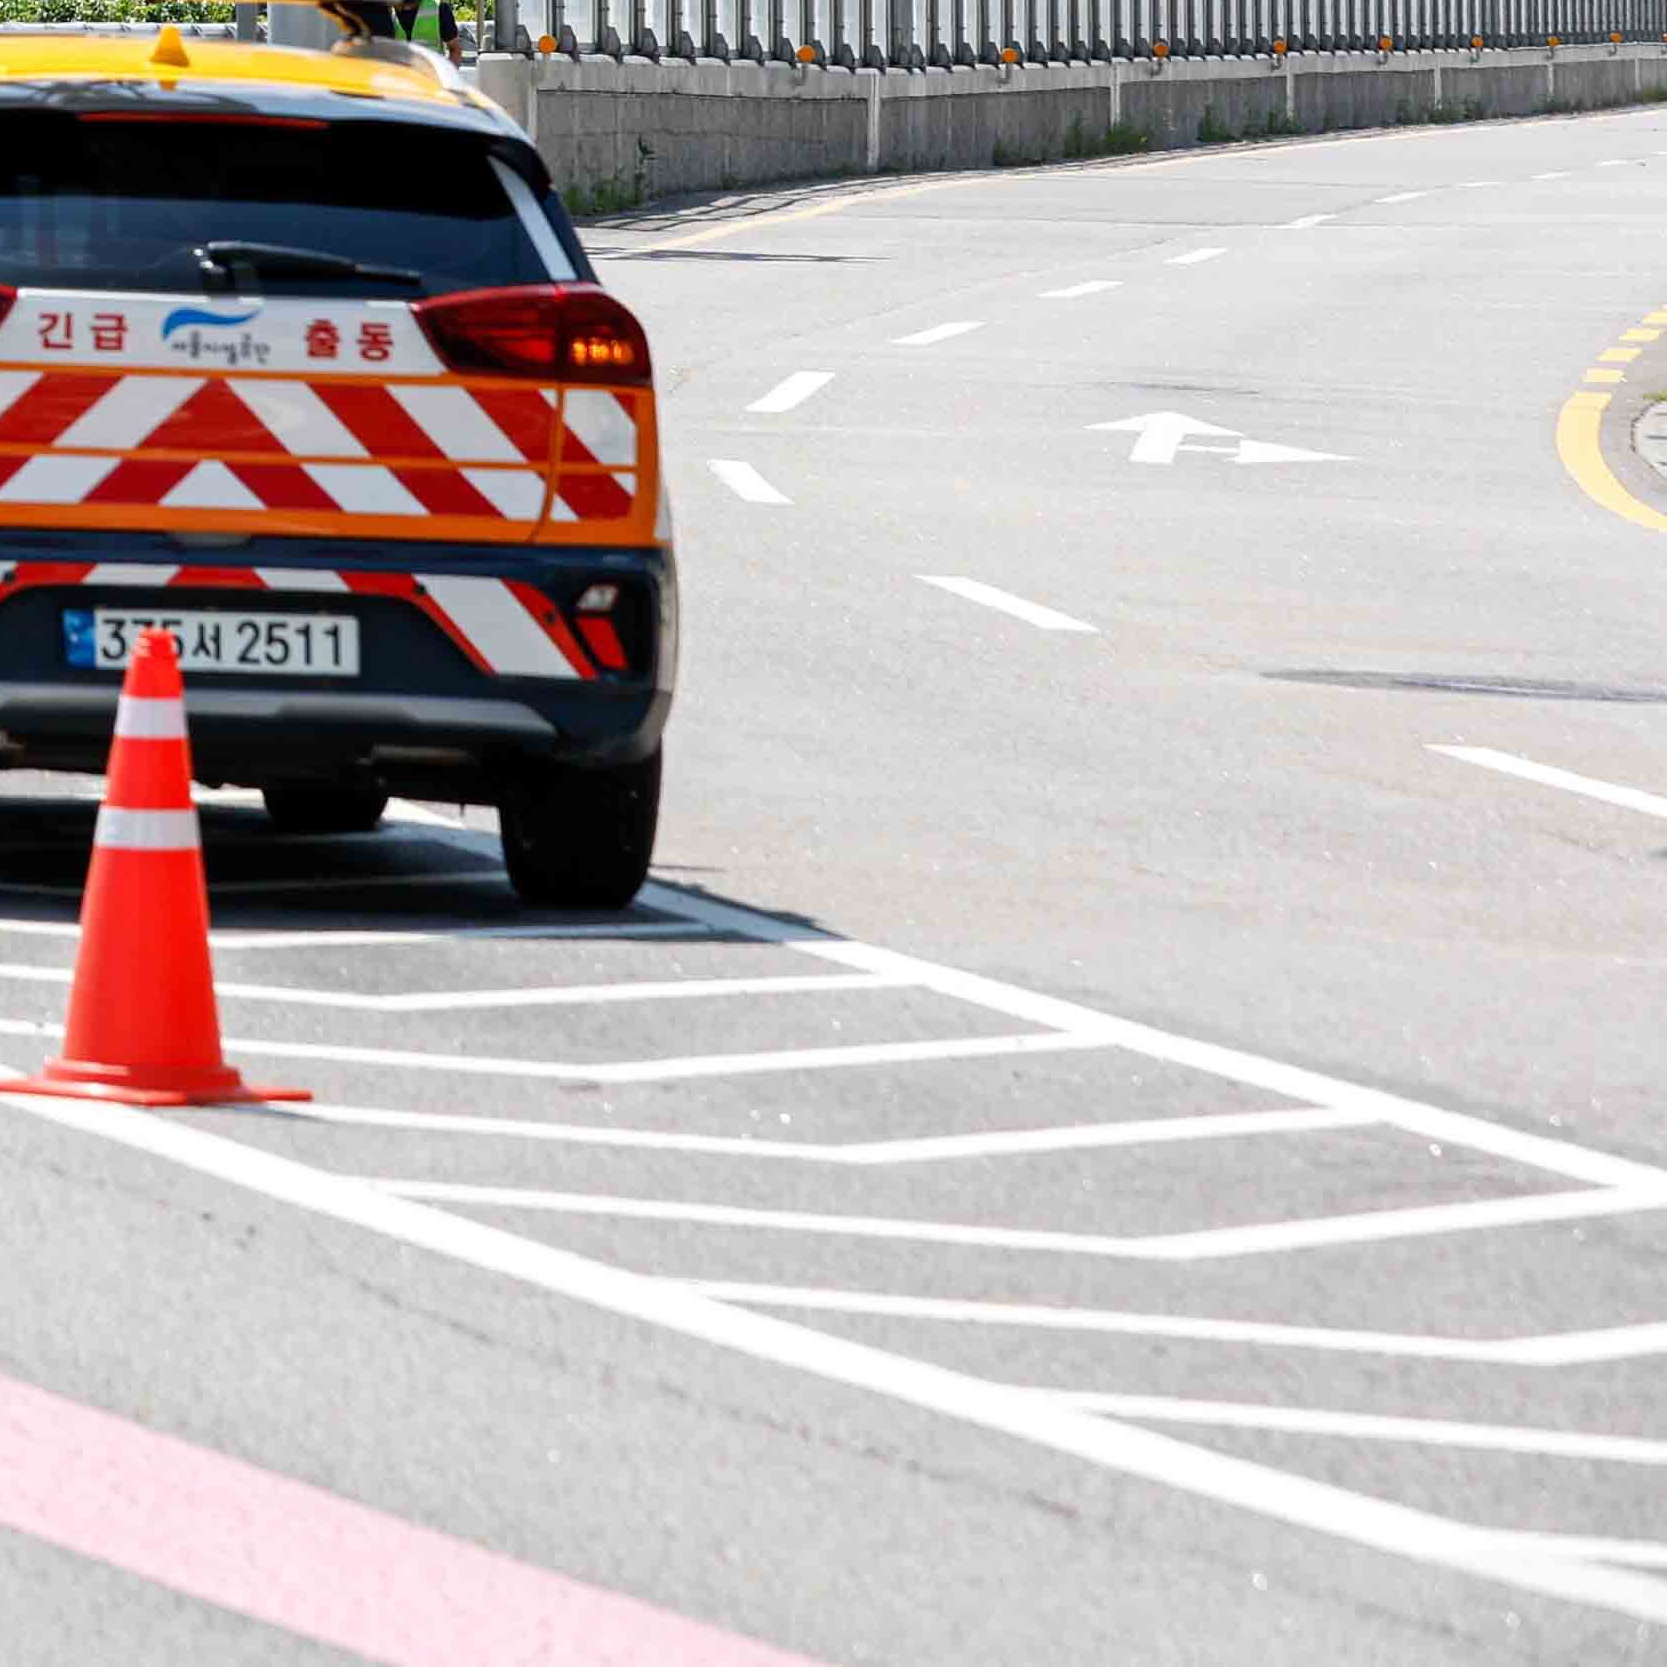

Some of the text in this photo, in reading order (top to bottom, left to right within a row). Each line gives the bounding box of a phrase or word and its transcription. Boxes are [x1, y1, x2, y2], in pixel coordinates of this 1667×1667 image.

[37, 312, 129, 352] 긴급
[304, 318, 394, 362] 출동
[101, 618, 342, 667] 35서 2511
